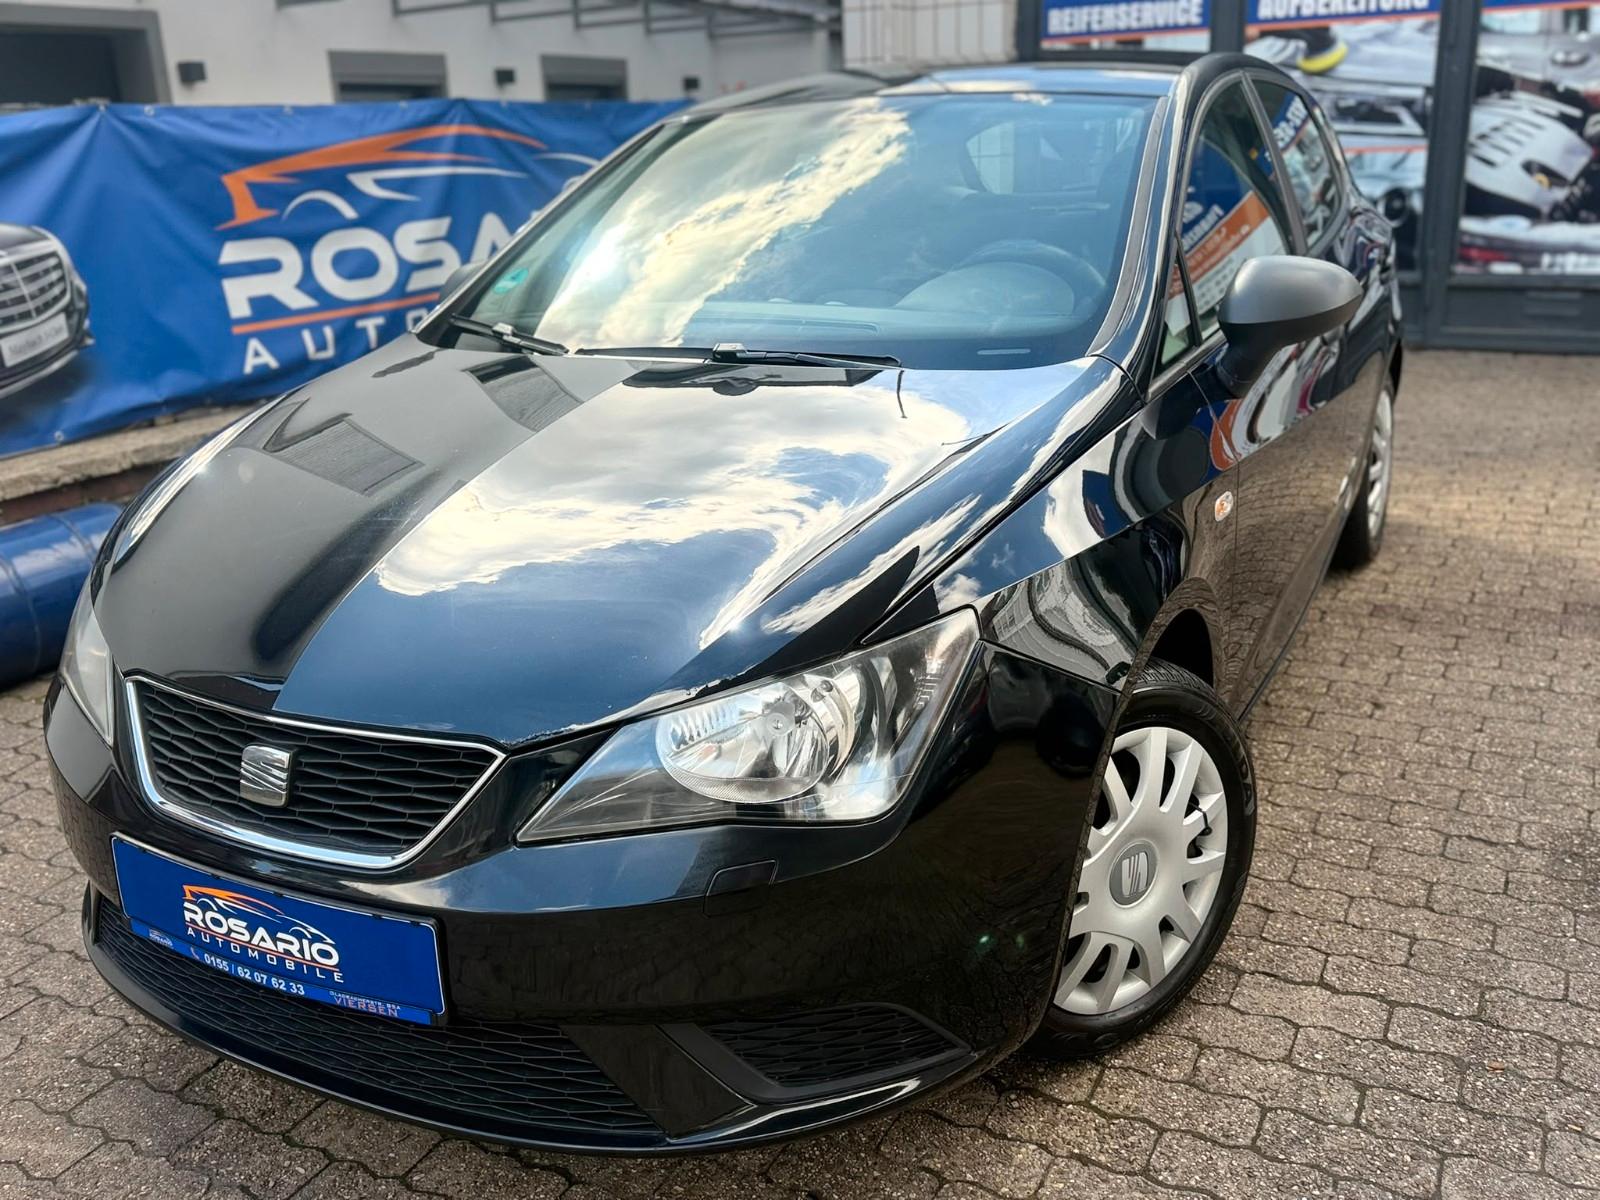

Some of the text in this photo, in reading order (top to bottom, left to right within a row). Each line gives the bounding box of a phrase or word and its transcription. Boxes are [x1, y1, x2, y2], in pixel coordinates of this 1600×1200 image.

[1048, 0, 1202, 34] REIFENSERVICE
[183, 902, 340, 967] ROSARIO
[187, 927, 344, 984] AUTOMOBILE
[204, 953, 229, 972] 0155
[237, 966, 252, 980] 62
[253, 971, 268, 985] 07
[271, 977, 287, 991] 62
[289, 982, 305, 996] 33
[333, 996, 398, 1017] VIERSEN
